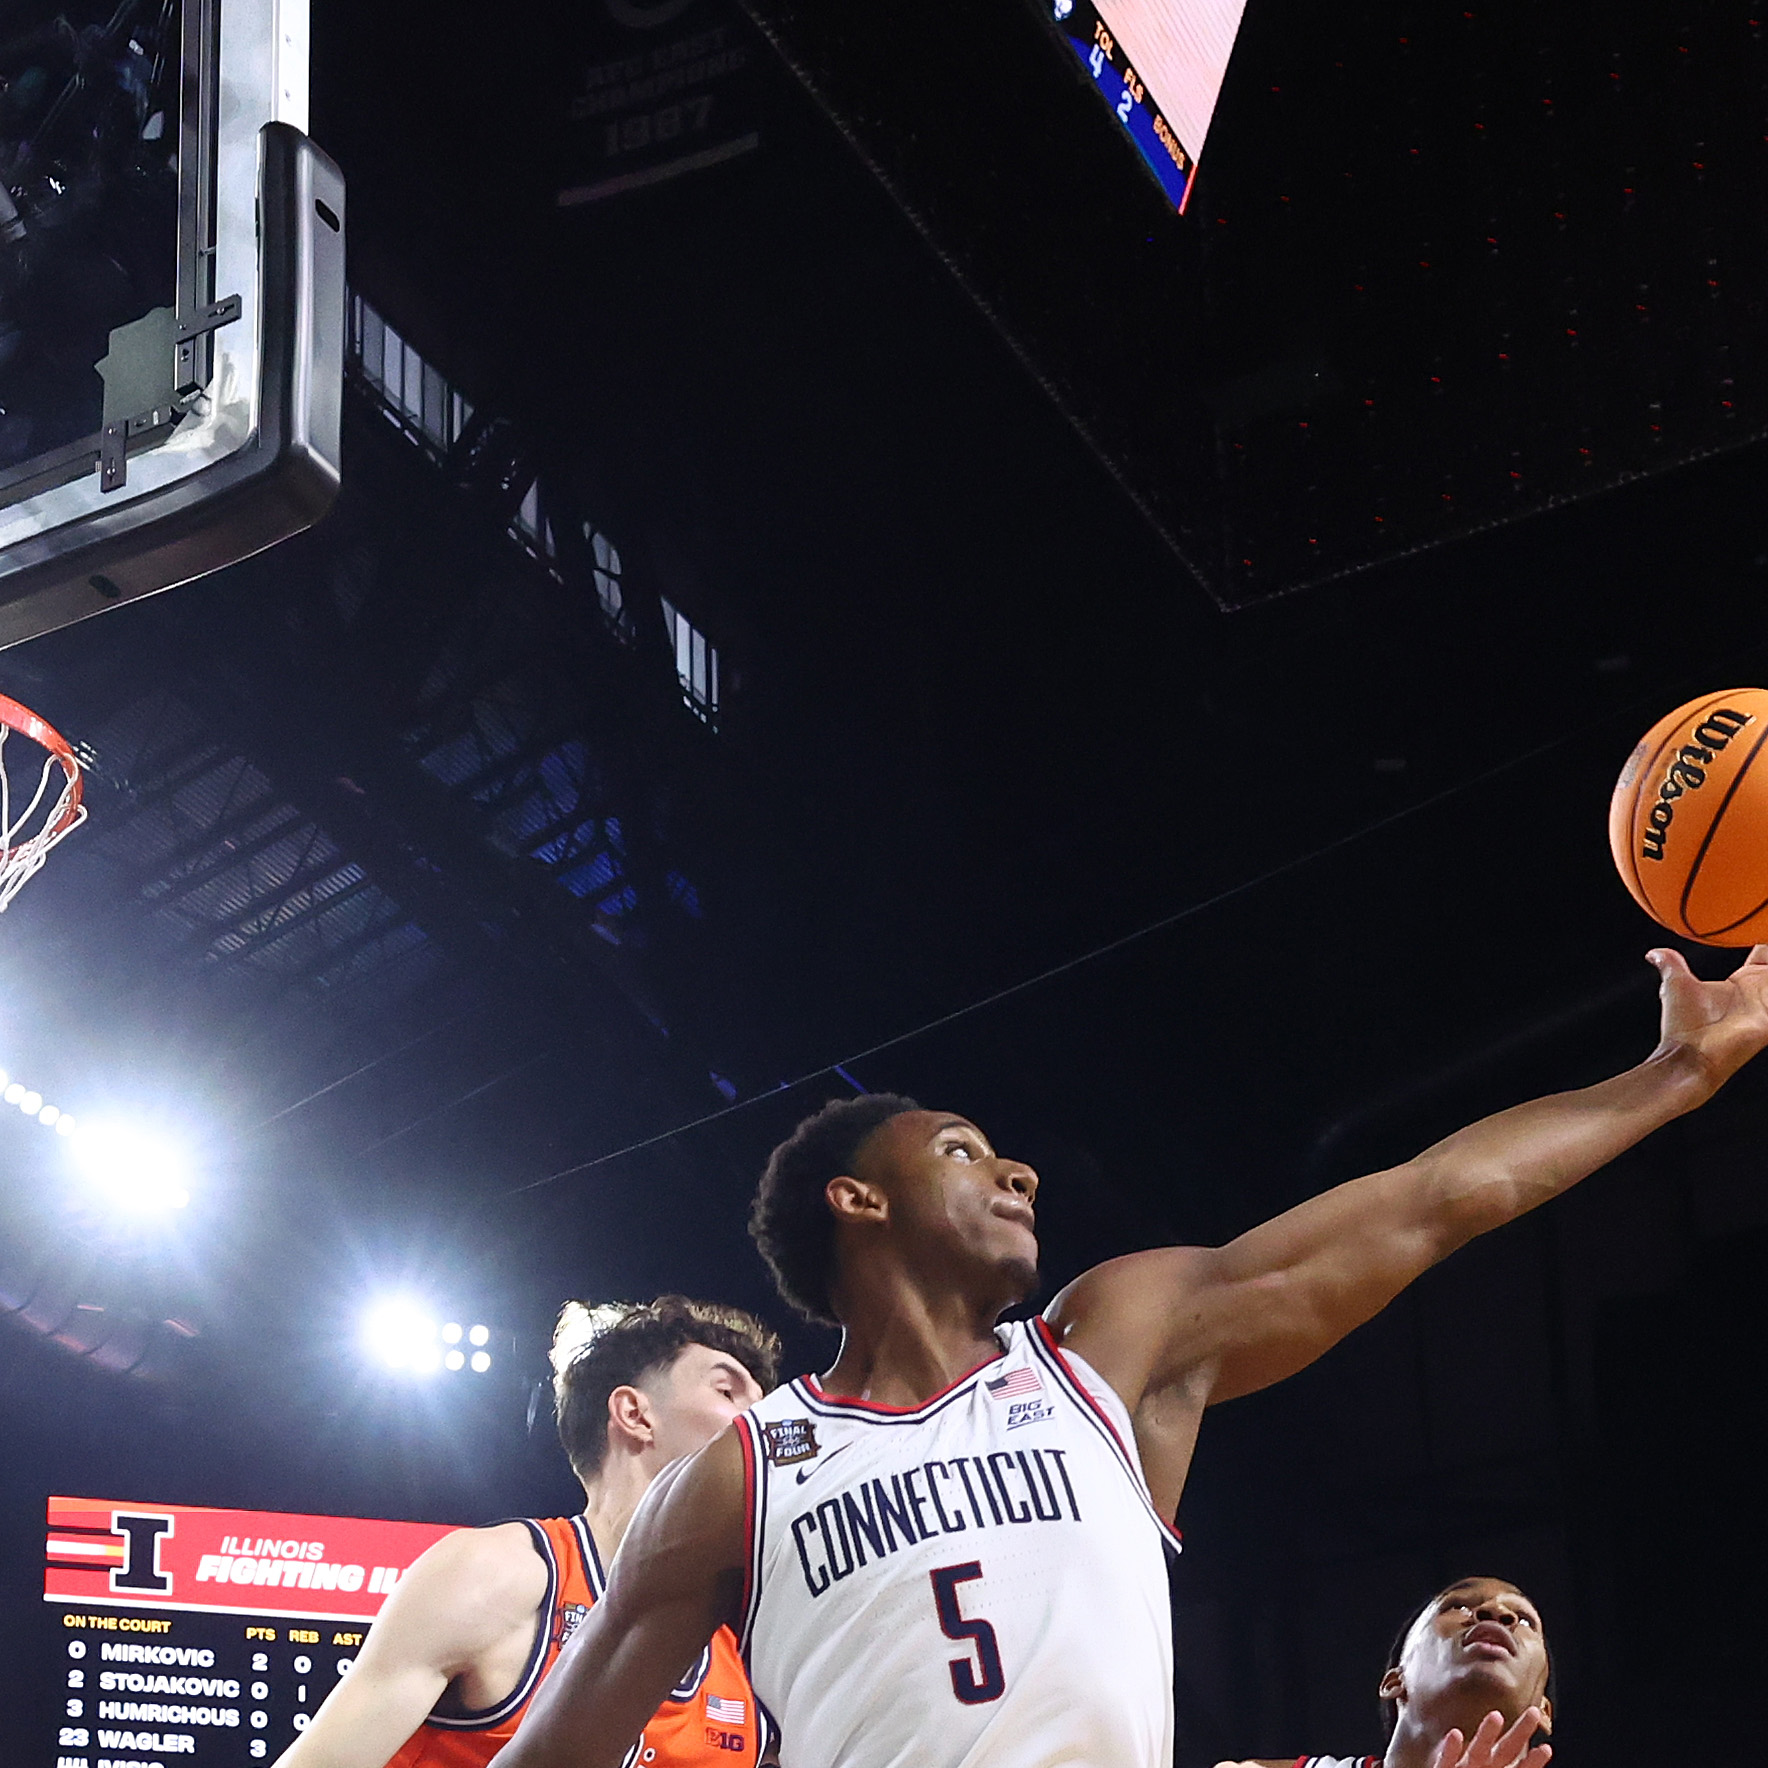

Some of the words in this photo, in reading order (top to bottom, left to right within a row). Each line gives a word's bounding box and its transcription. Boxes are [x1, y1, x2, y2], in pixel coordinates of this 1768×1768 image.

[1089, 44, 1104, 79] 4
[1117, 91, 1133, 123] 2
[1642, 708, 1756, 862] Wilson
[1007, 1406, 1055, 1425] EAST
[1009, 1399, 1042, 1414] BIG
[770, 1425, 807, 1439] FINAL
[776, 1442, 811, 1458] FOUR
[791, 1449, 1082, 1598] CONNECTICUT
[221, 1536, 325, 1561] ILLINOIS
[196, 1555, 364, 1593] FIGHTING
[367, 1567, 416, 1595] IL
[63, 1615, 85, 1628] ON
[88, 1616, 117, 1631] THE
[119, 1618, 171, 1633] COURT
[246, 1627, 276, 1641] PTS
[289, 1629, 319, 1643] REB
[332, 1632, 362, 1647] AST
[930, 1560, 1005, 1704] 5
[68, 1640, 86, 1660] 0
[101, 1643, 215, 1669] MIRKOVIC
[252, 1653, 268, 1671] 2
[294, 1655, 312, 1674] 0
[68, 1669, 84, 1688] 2
[99, 1672, 240, 1699] STOJAKOVIC
[251, 1682, 268, 1701] 0
[66, 1699, 83, 1718] 3
[98, 1701, 240, 1728] HUMRICHOUS
[251, 1711, 268, 1729] 0
[293, 1713, 309, 1731] 0
[58, 1729, 89, 1748] 23
[97, 1730, 195, 1754] WAGLER
[250, 1740, 266, 1758] 3
